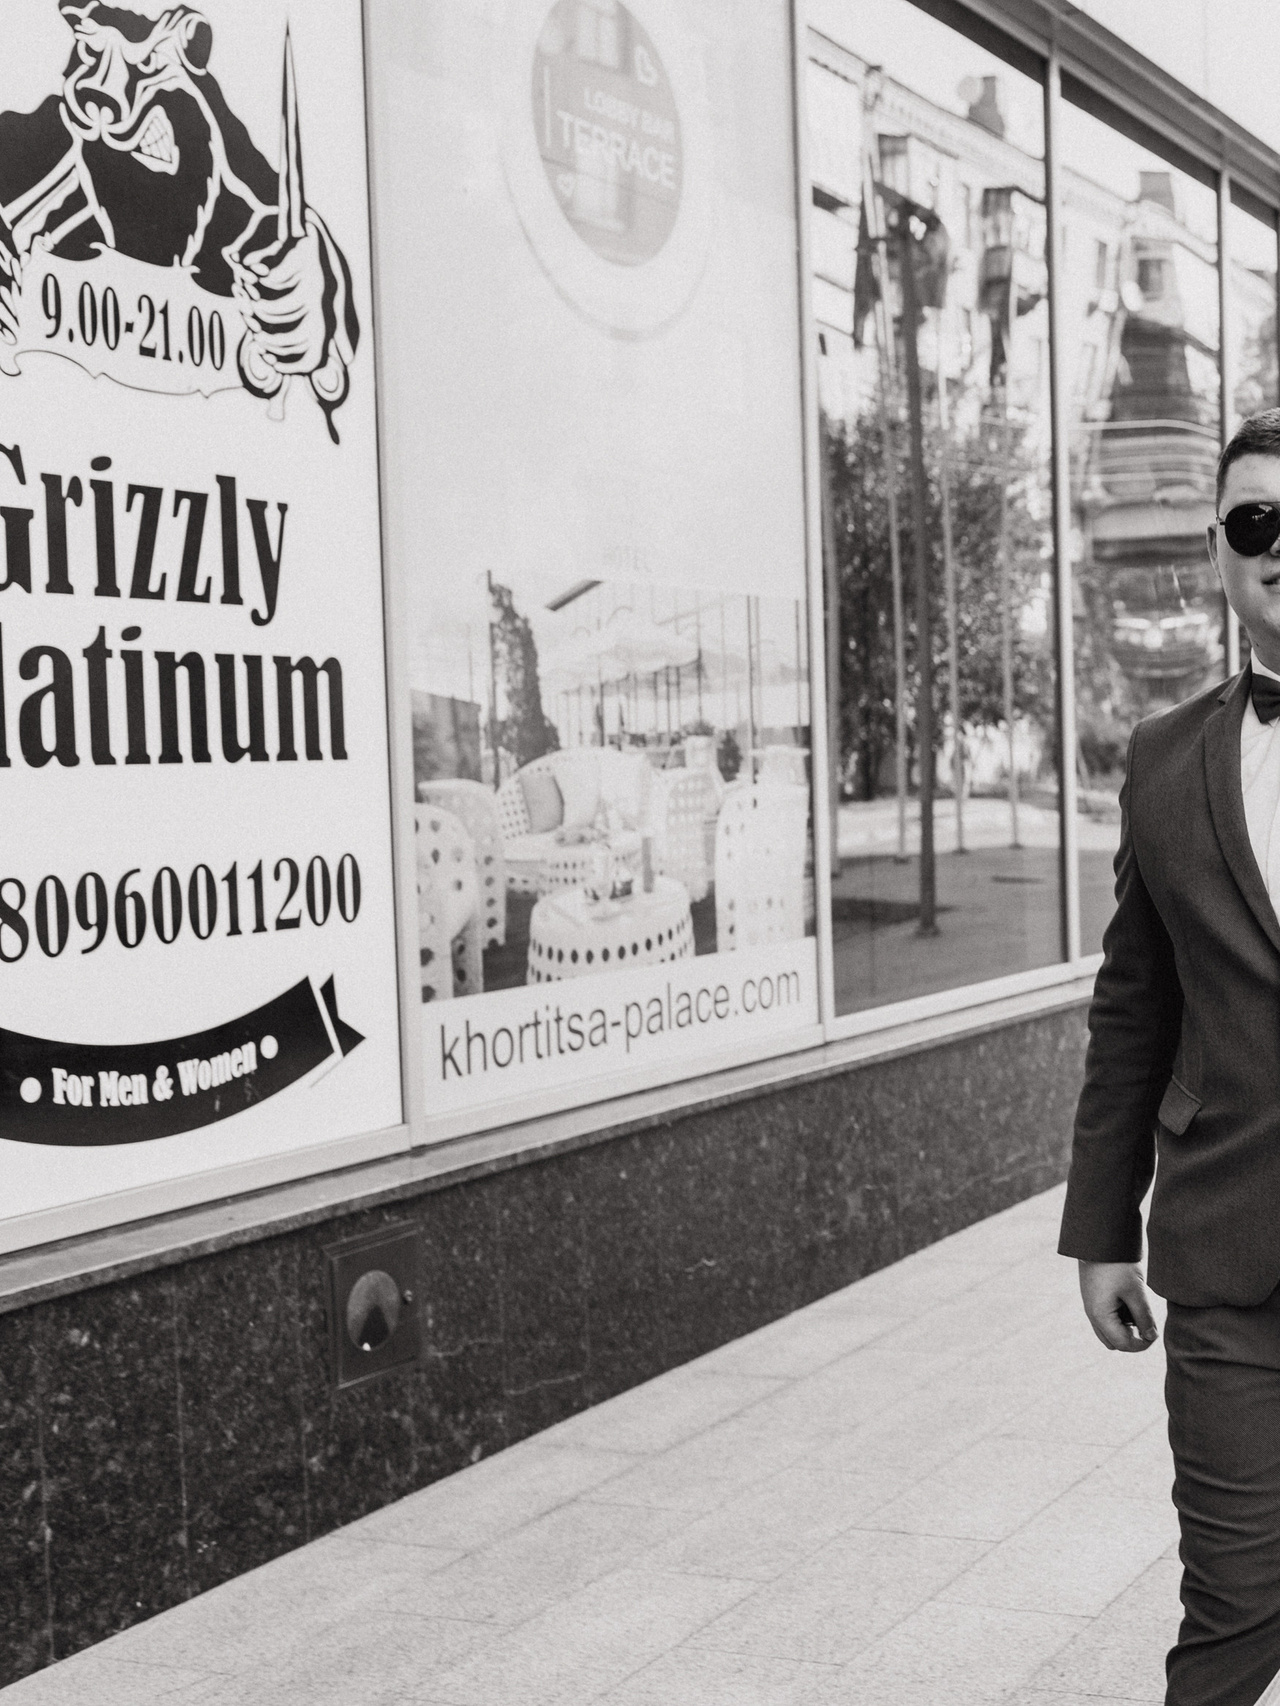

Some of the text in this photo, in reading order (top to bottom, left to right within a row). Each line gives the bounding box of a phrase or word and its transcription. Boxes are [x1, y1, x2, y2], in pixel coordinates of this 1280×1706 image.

[556, 109, 677, 191] TERRACE
[41, 273, 225, 371] 9.00-21.00
[0, 622, 348, 768] atinum
[440, 970, 800, 1080] khortitsa-palace.com
[51, 1041, 258, 1108] For Men & Women
